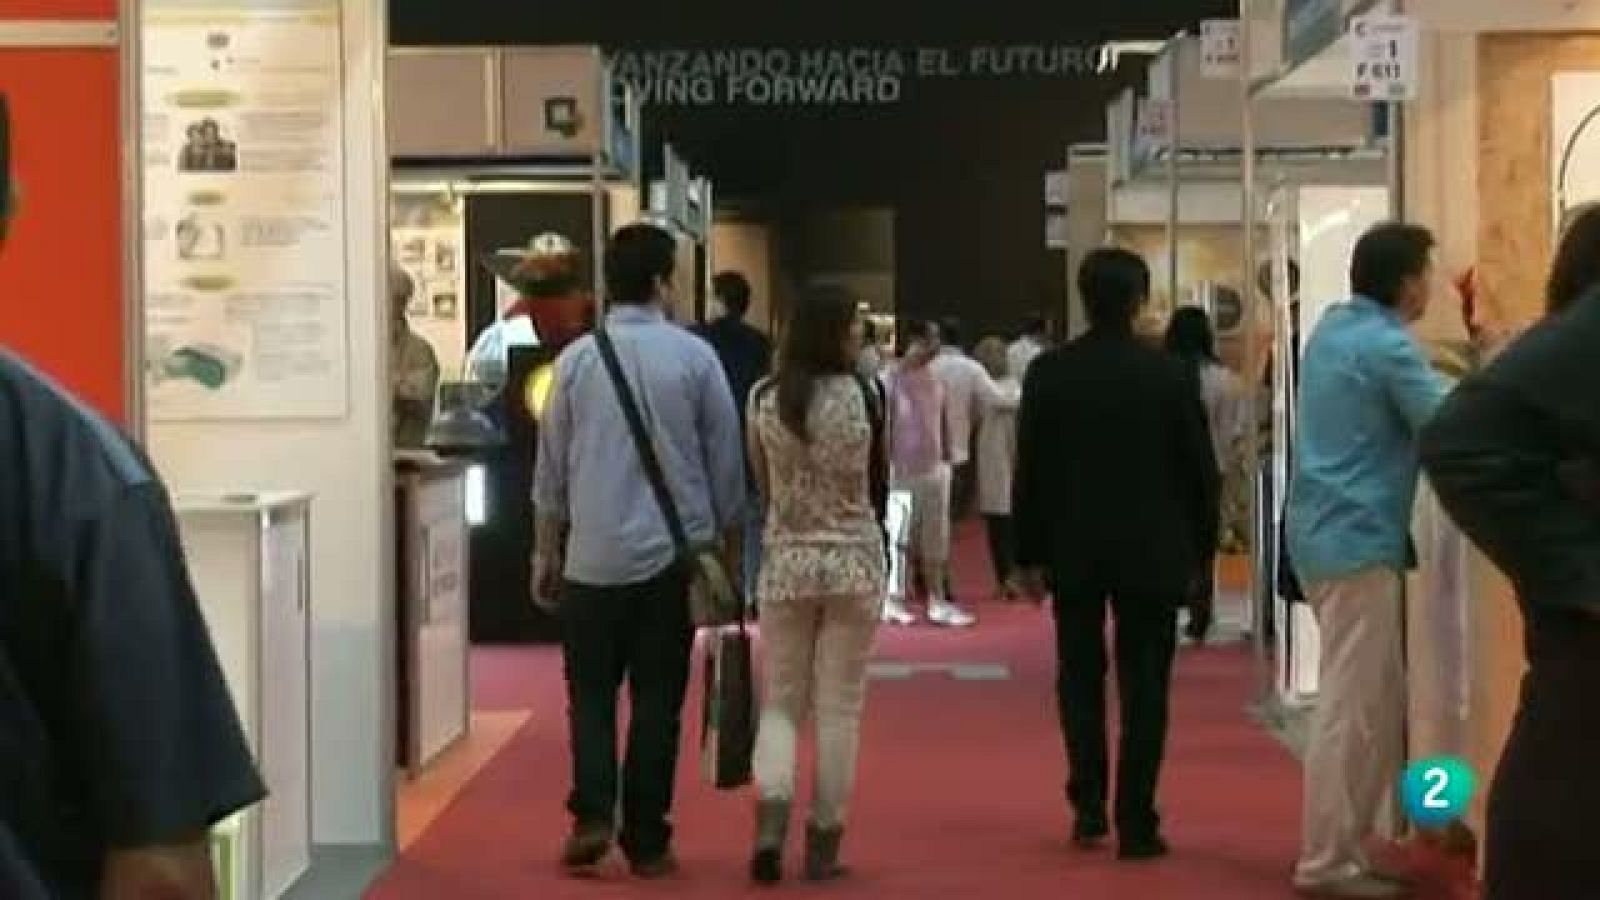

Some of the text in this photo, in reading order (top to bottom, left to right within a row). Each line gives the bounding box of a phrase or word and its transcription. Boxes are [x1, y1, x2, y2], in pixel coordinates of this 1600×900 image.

[801, 49, 904, 77] HACIA
[919, 49, 960, 75] EL
[727, 76, 900, 104] FORWARD
